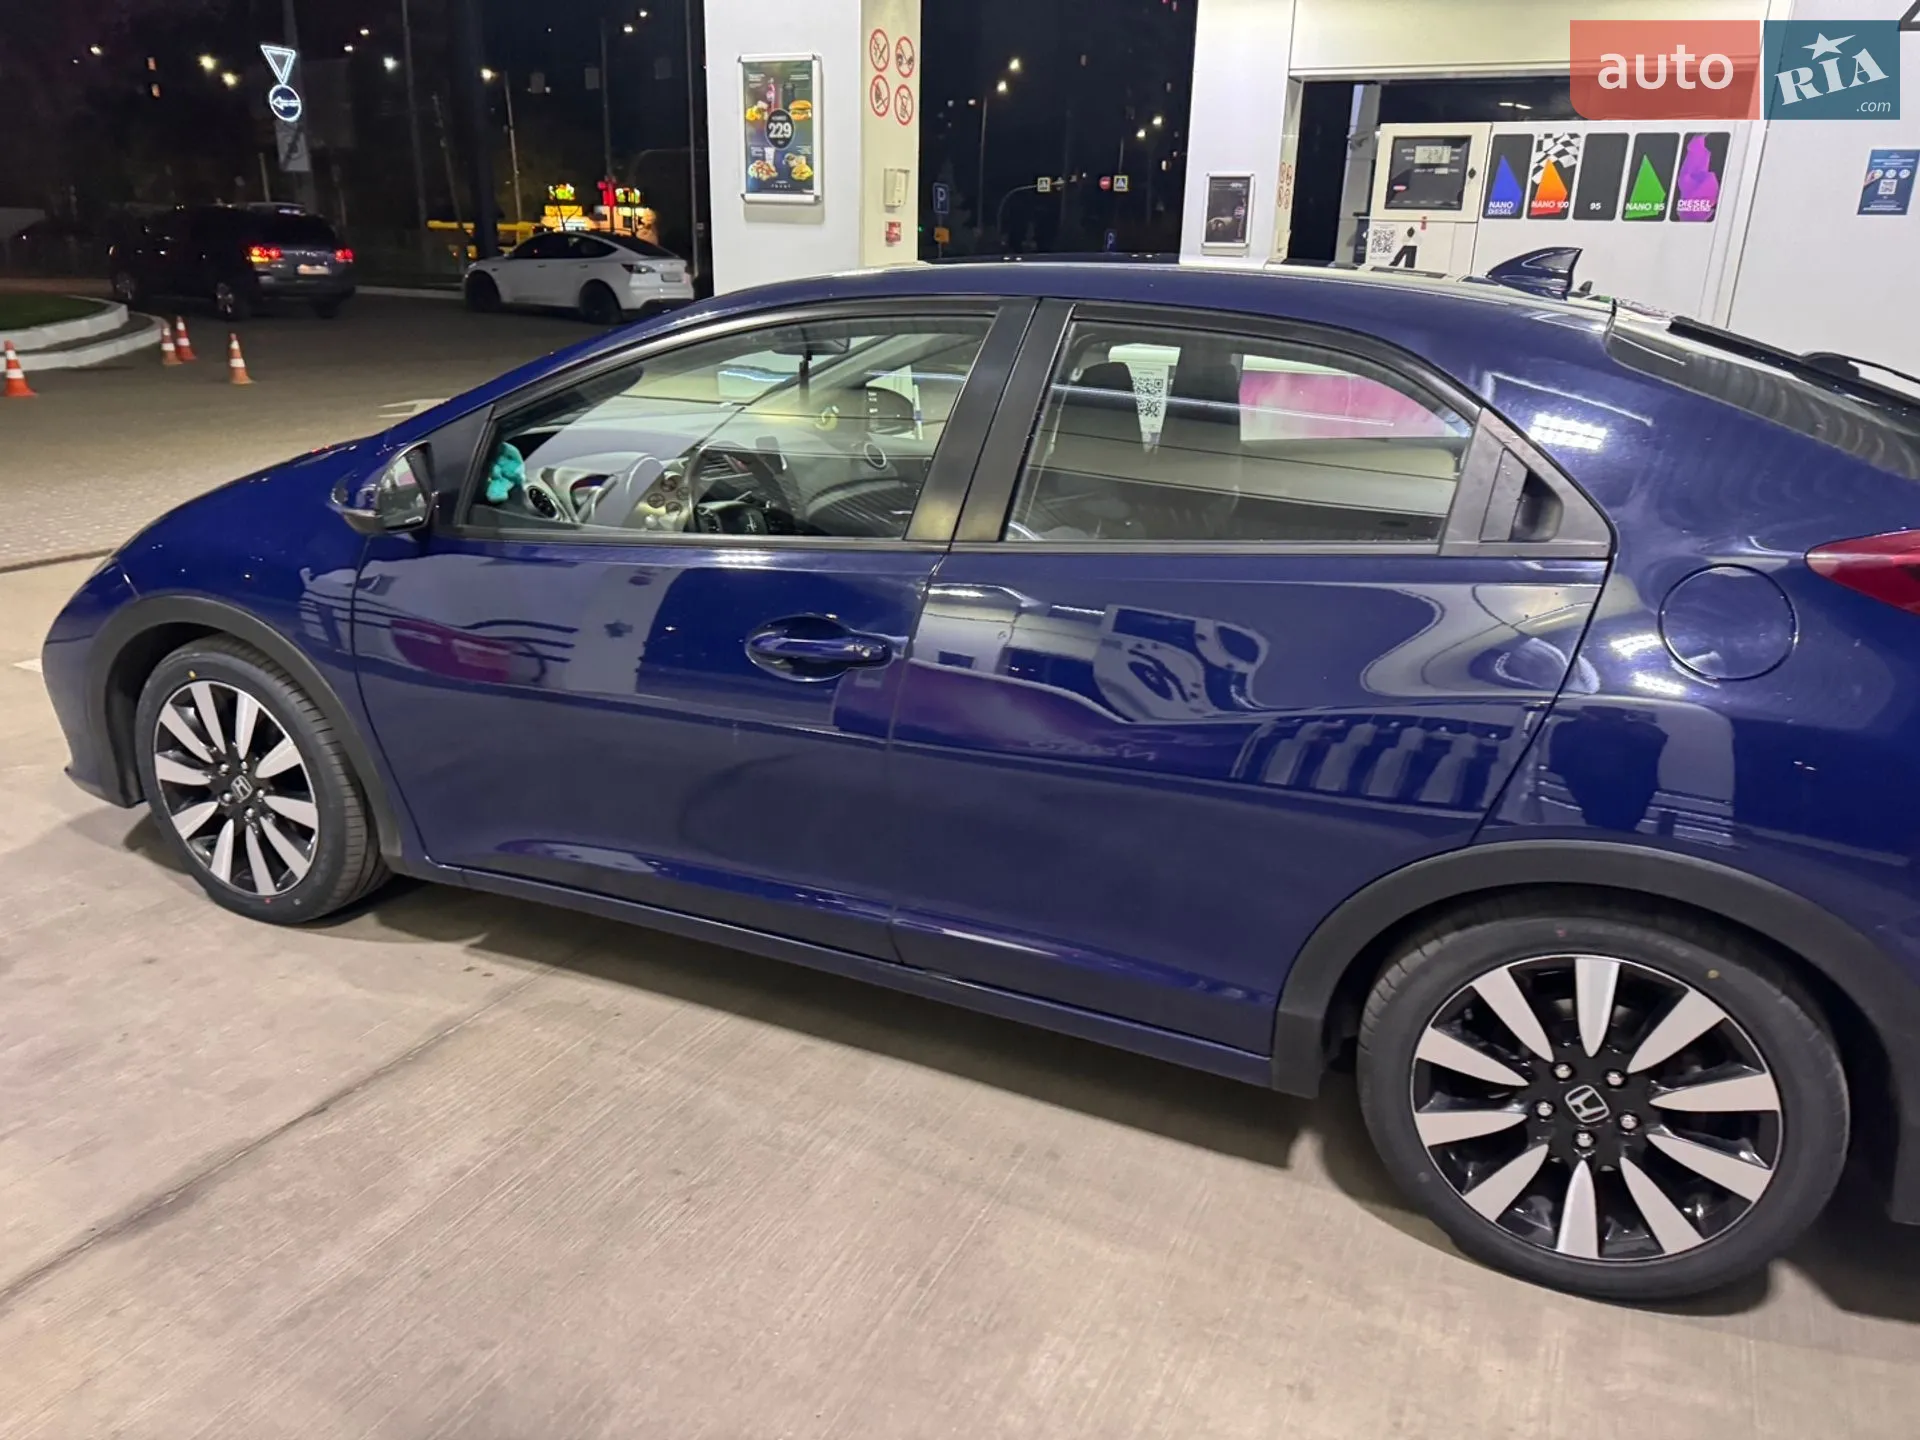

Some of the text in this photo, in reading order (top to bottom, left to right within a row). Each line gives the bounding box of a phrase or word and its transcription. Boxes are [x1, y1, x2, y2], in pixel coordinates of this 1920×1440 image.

[768, 122, 792, 138] 229
[1488, 201, 1514, 209] NANO
[1531, 201, 1554, 209] NANO
[1589, 202, 1601, 210] 95
[1625, 203, 1652, 211] NANO
[1677, 199, 1711, 208] DIESEL
